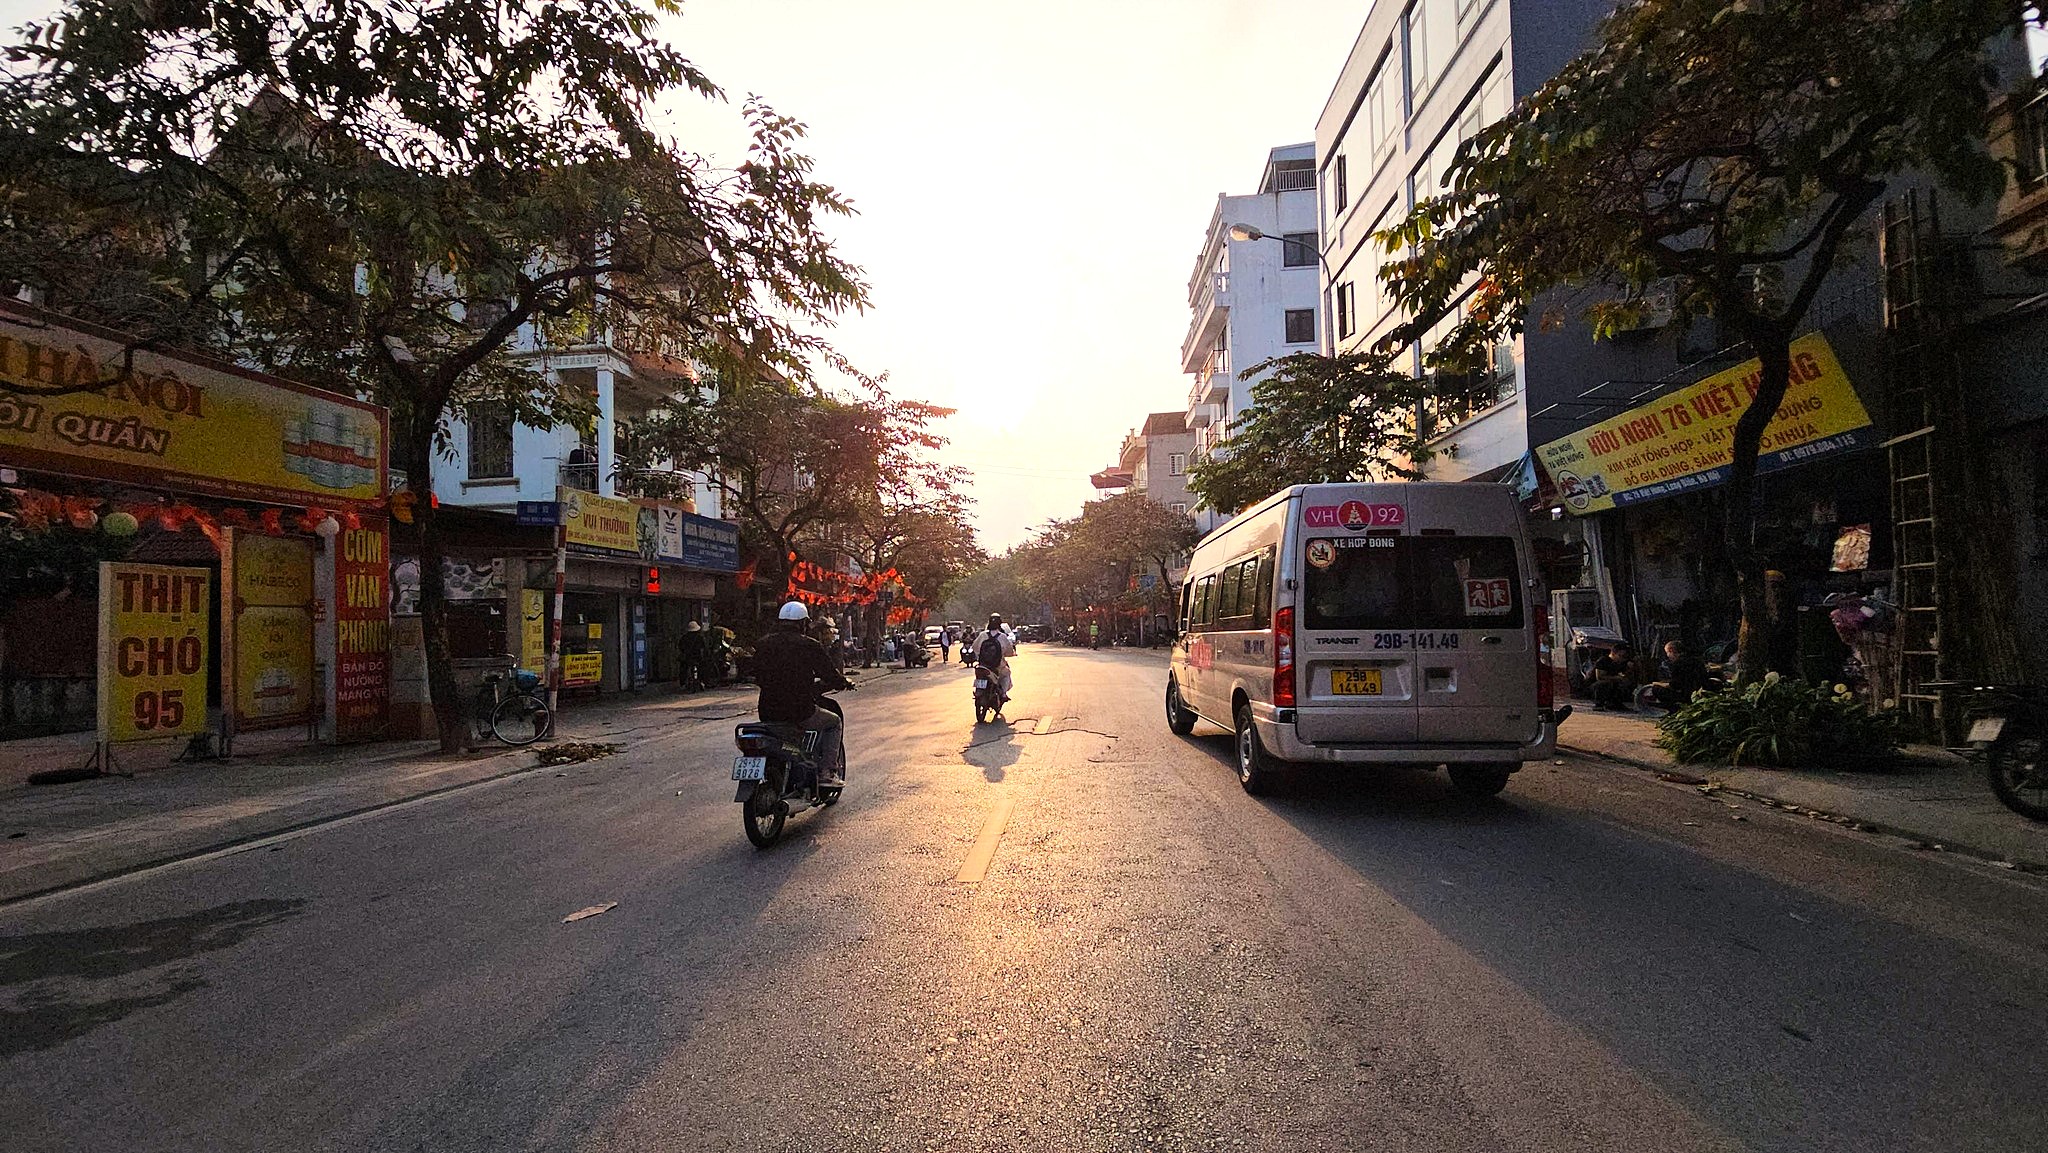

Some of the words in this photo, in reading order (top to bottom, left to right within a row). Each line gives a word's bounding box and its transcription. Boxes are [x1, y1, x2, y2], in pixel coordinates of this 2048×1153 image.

[54, 414, 170, 454] QUÁN
[1586, 430, 1621, 457] HỮU
[1618, 413, 1668, 447] NGHỊ
[1660, 403, 1694, 430] 76
[1687, 382, 1742, 421] VIỆT
[1606, 460, 1626, 474] KIM
[1623, 453, 1642, 469] KHÍ
[1700, 428, 1726, 445] VẬT
[1640, 470, 1660, 482] GIA
[1311, 510, 1333, 523] VH
[1378, 507, 1400, 522] 92
[344, 527, 382, 564] CƠM
[1333, 538, 1346, 549] XE
[116, 571, 206, 623] THỊT
[345, 567, 381, 609] VĂN
[117, 628, 202, 677] CHÓ
[1315, 637, 1360, 645] TRANSIT
[1374, 632, 1459, 651] 29B-141.49
[338, 688, 373, 702] MANG
[1338, 683, 1377, 694] 141.49
[1346, 671, 1367, 682] 29B
[133, 688, 184, 731] 95
